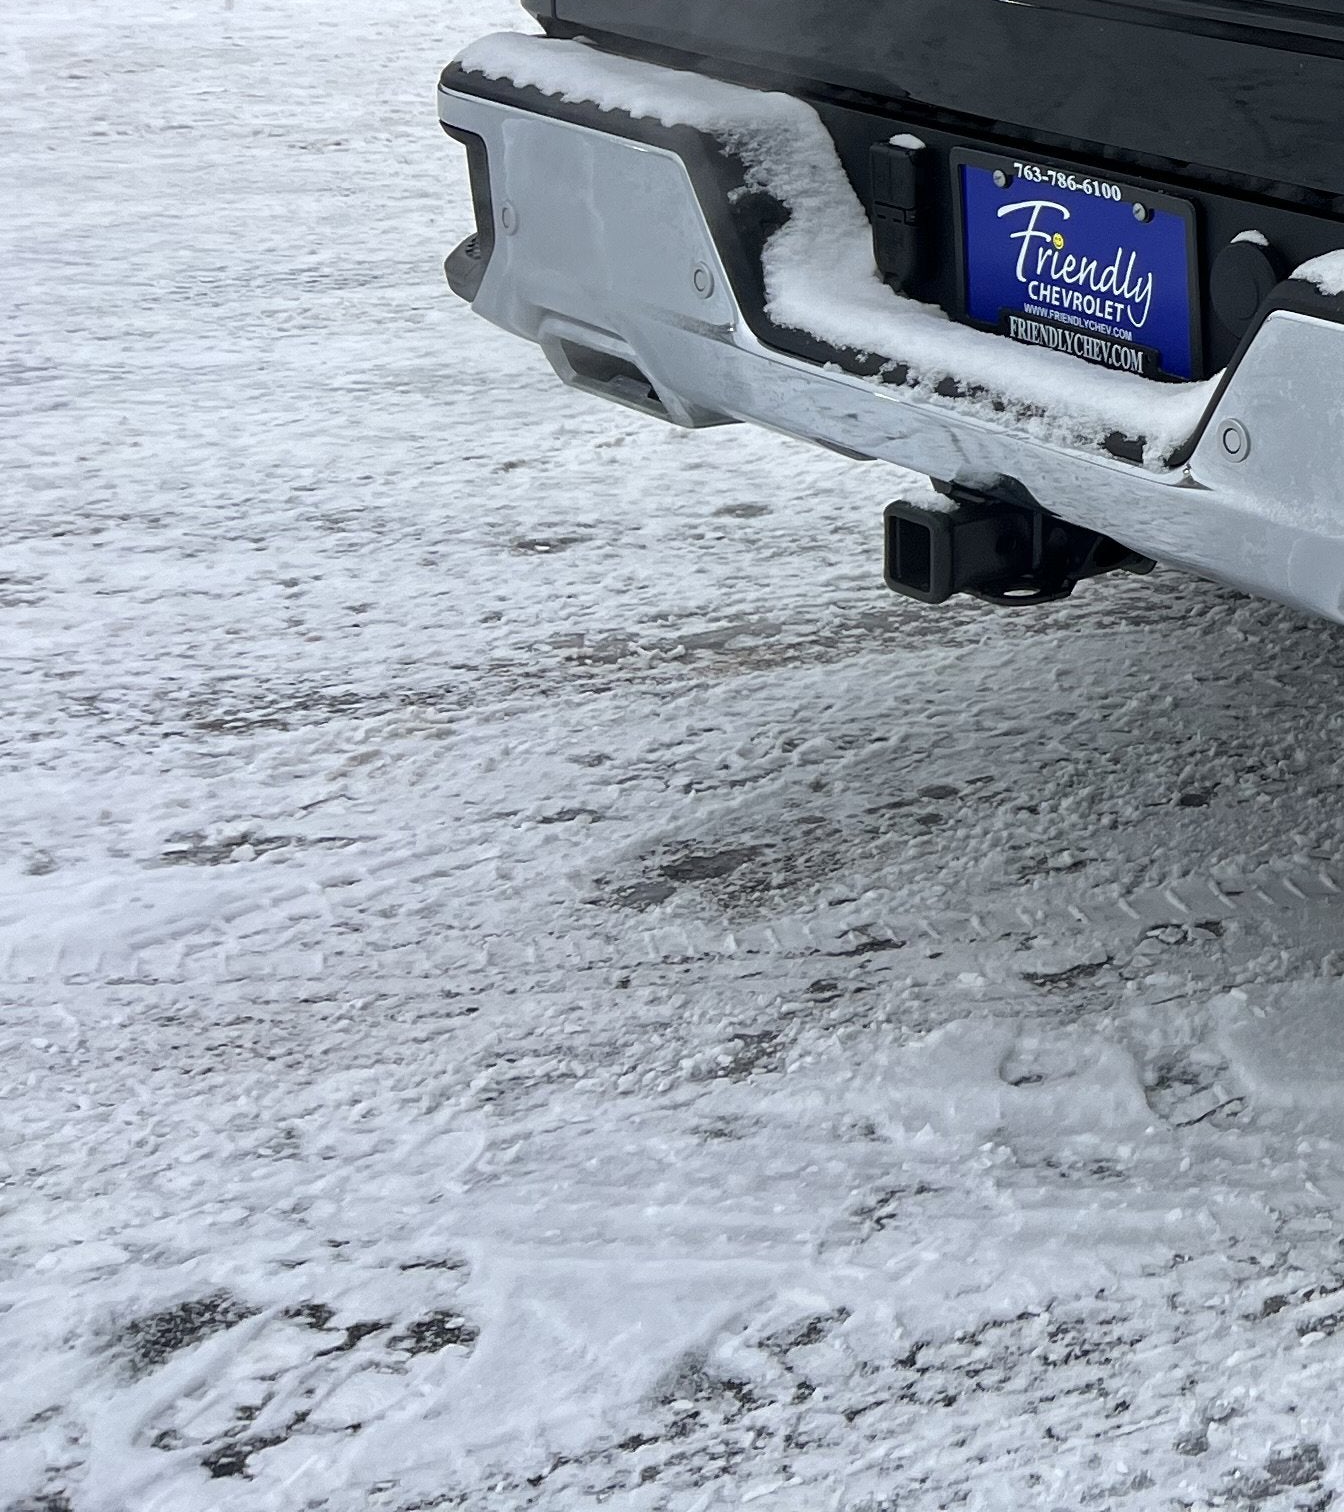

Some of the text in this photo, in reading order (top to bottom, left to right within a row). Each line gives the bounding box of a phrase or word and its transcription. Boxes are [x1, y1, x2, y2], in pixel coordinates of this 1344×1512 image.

[1013, 162, 1122, 201] 763-786-6100
[998, 200, 1152, 328] Friendly
[1023, 302, 1133, 342] WWW.FRIENDLYCHEV.COM
[1028, 280, 1125, 323] CHEVROLET
[1009, 315, 1143, 374] FRIENDLYCHEV.COM
